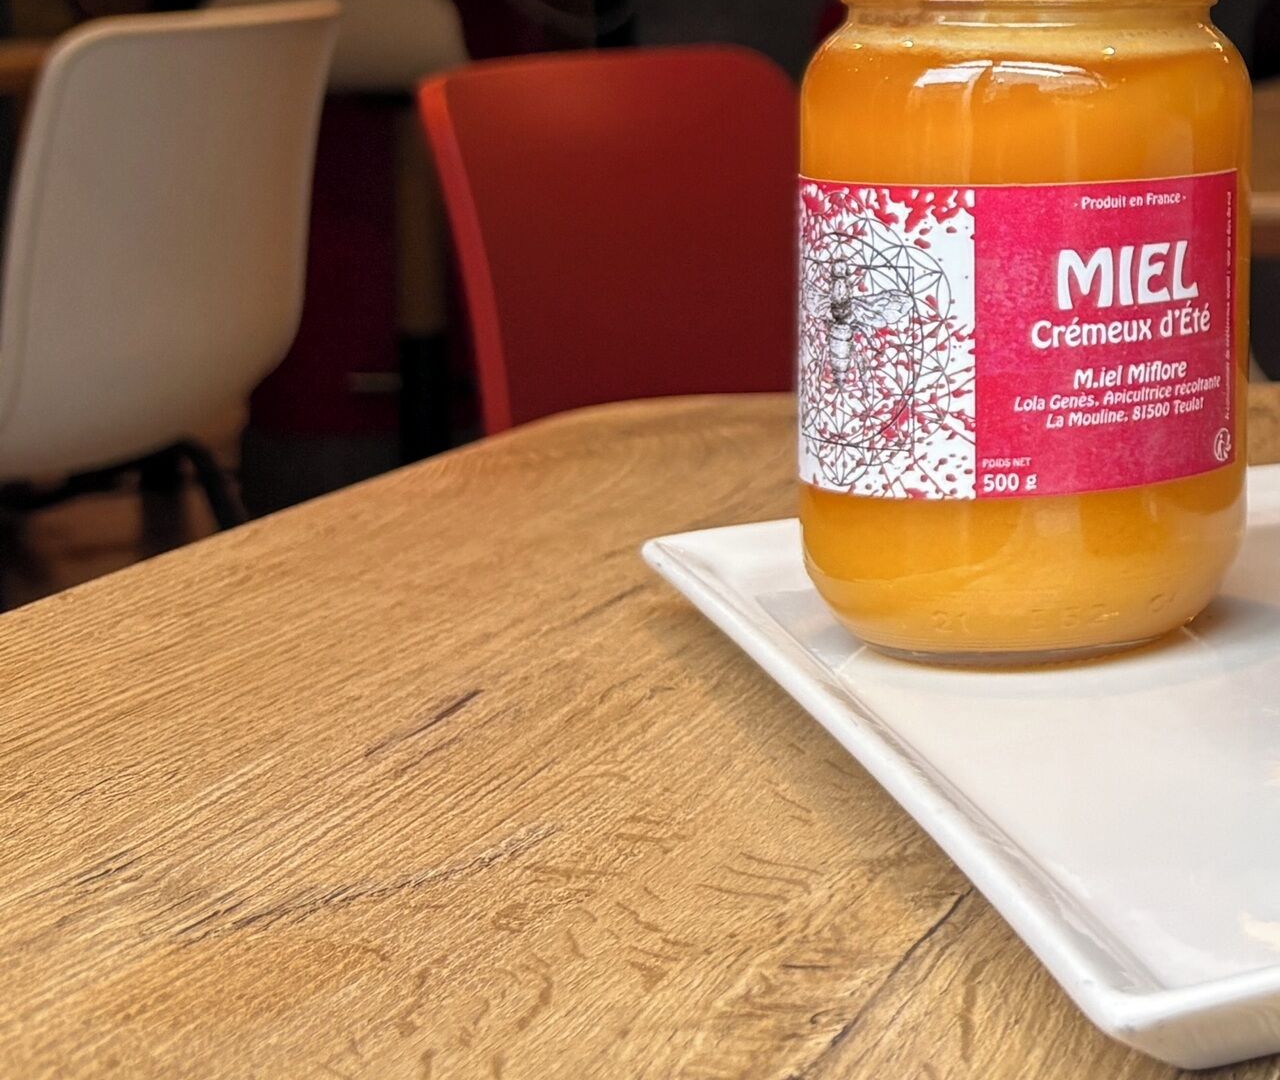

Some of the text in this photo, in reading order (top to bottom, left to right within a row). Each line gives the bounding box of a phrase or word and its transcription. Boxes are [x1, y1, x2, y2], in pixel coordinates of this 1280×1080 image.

[1081, 192, 1180, 209] Produit en France
[1057, 241, 1198, 309] MIEL
[1030, 314, 1151, 349] Crémeux
[1074, 361, 1186, 390] M.iel Miflore
[1014, 374, 1221, 411] Lola Genès, Apicultrice récoltante
[1046, 400, 1204, 428] La Mouline, 81500 Teulat
[983, 474, 1037, 491] 500 g
